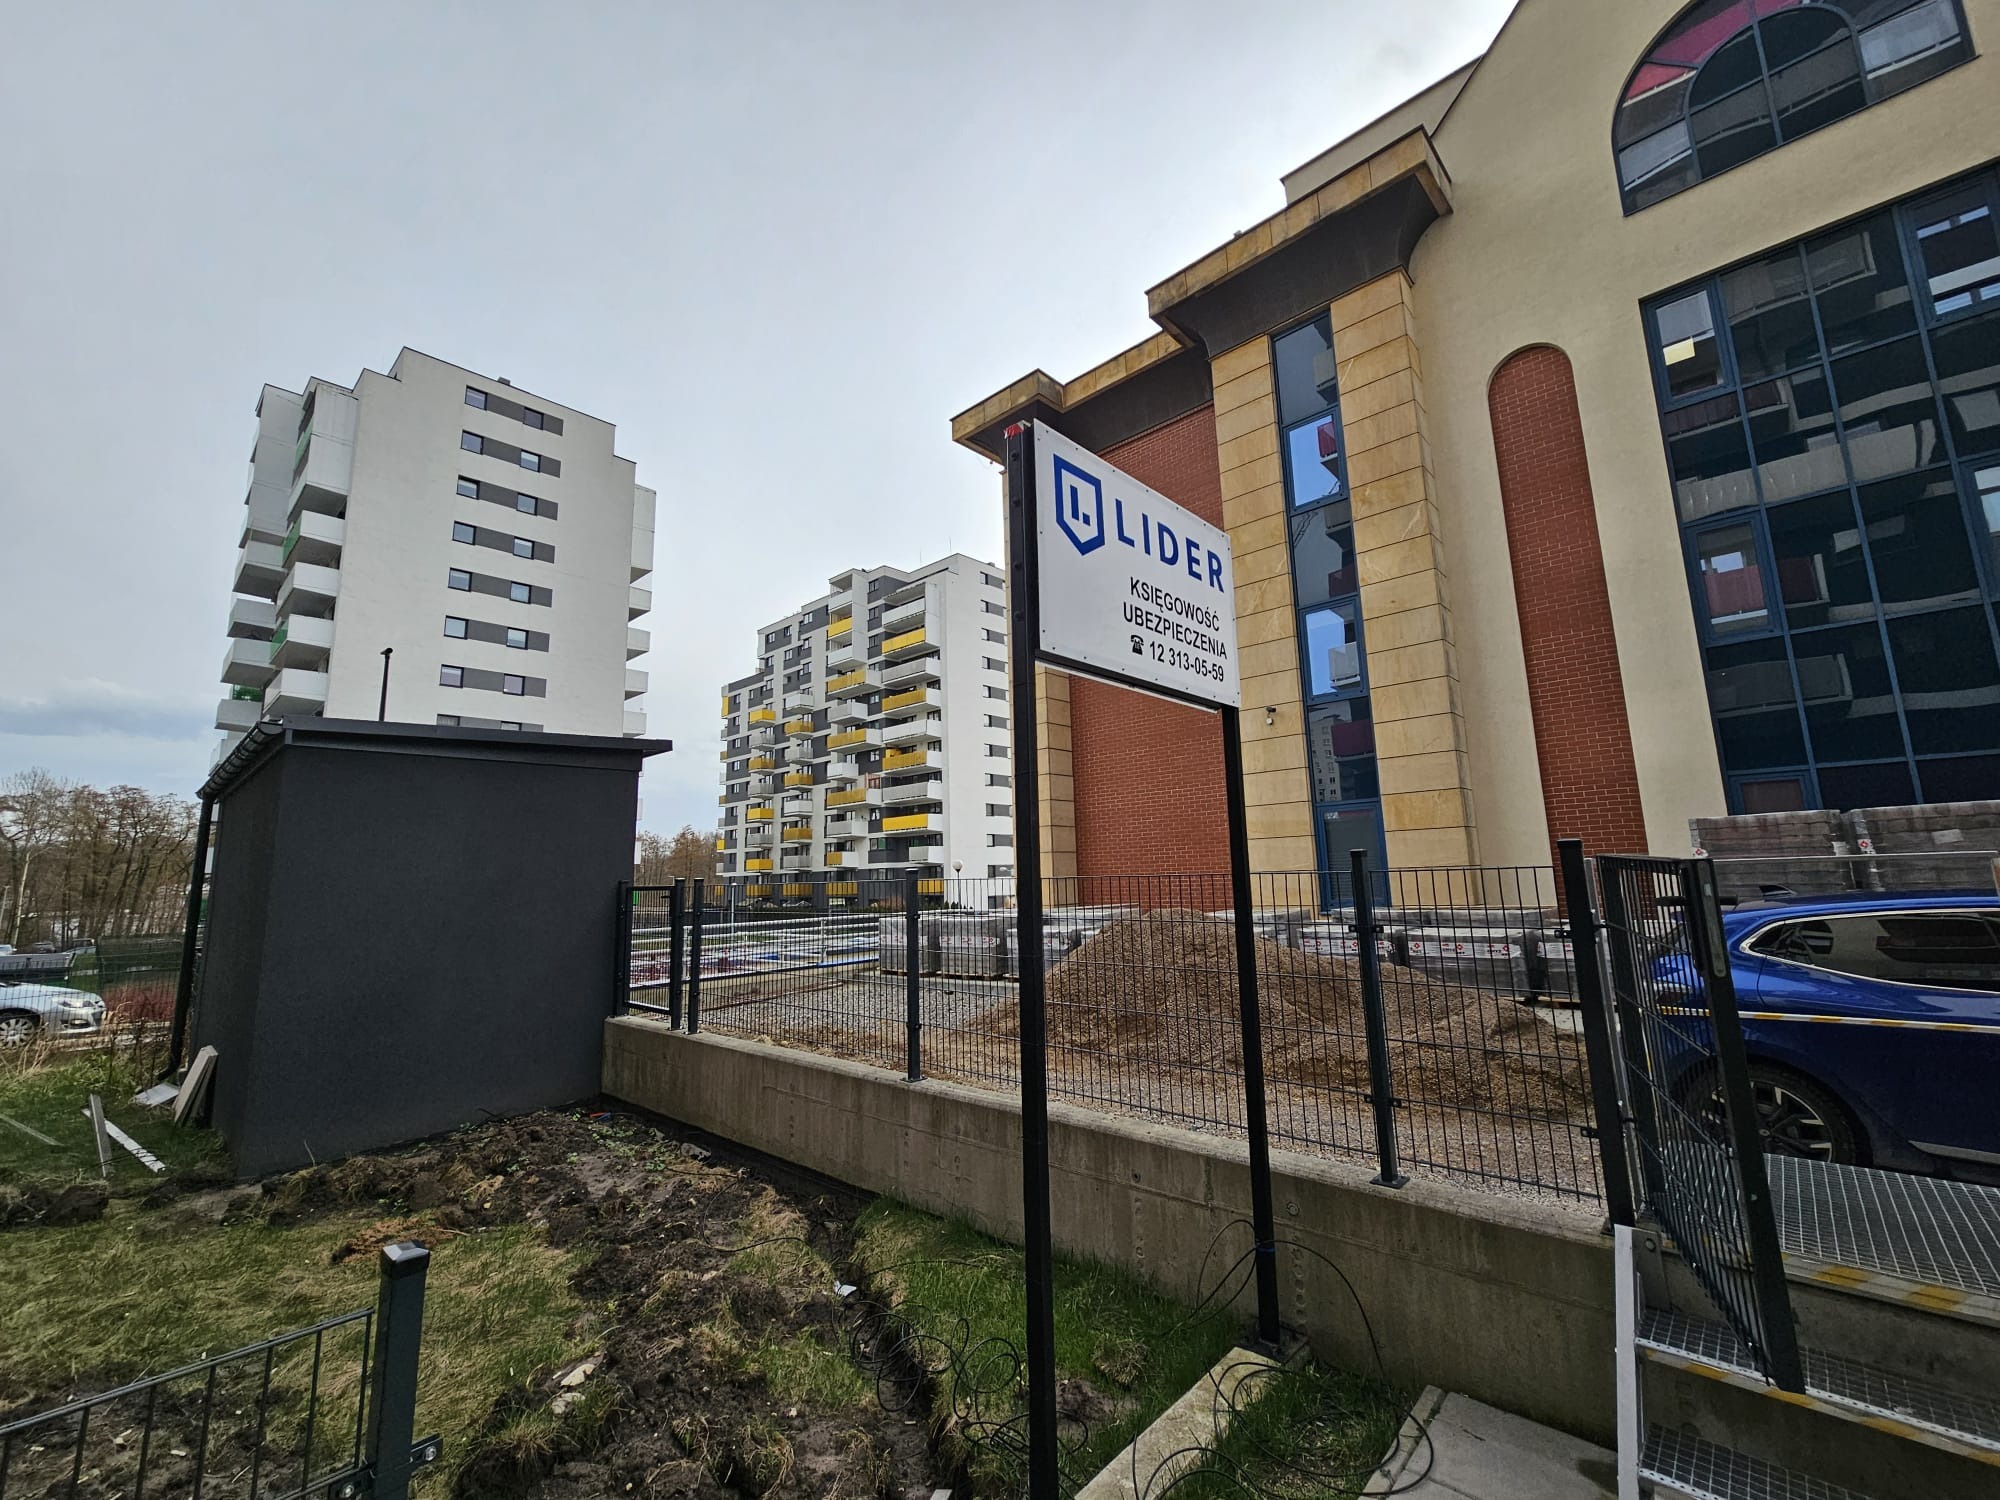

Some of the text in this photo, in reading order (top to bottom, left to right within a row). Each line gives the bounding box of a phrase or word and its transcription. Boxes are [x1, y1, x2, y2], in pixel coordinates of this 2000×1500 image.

[1115, 498, 1225, 593] LIDER
[1123, 601, 1228, 660] UBEZPIECZENIA
[1130, 576, 1220, 632] KSIĘGOWOŚĆ
[1149, 640, 1224, 682] 12 313-05-59
